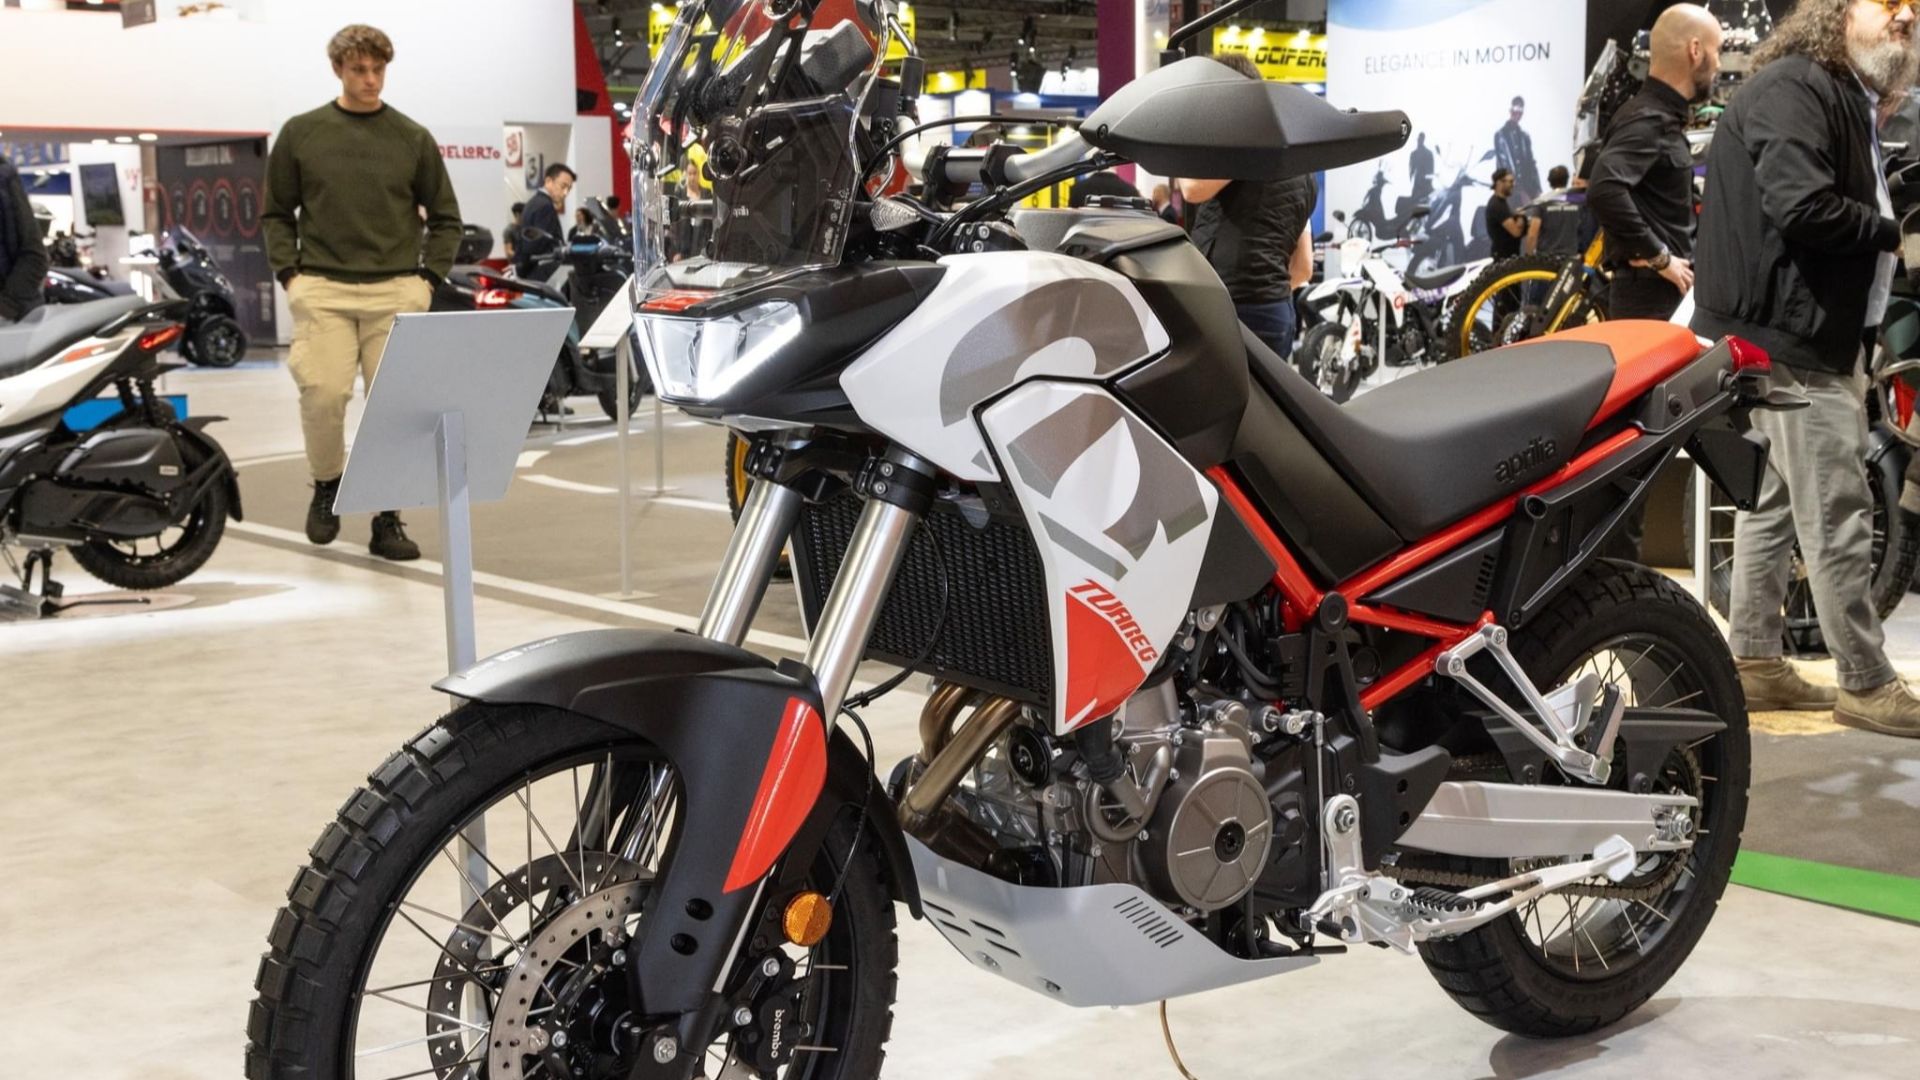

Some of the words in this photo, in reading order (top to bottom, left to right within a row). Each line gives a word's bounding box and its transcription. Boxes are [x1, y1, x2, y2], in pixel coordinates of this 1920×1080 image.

[1365, 50, 1447, 75] ELEGANCE
[1453, 48, 1470, 66] IN
[1476, 42, 1551, 65] MOTION
[1495, 436, 1556, 484] aprilia
[1069, 578, 1158, 662] TUAREG
[771, 1009, 786, 1059] brembo
